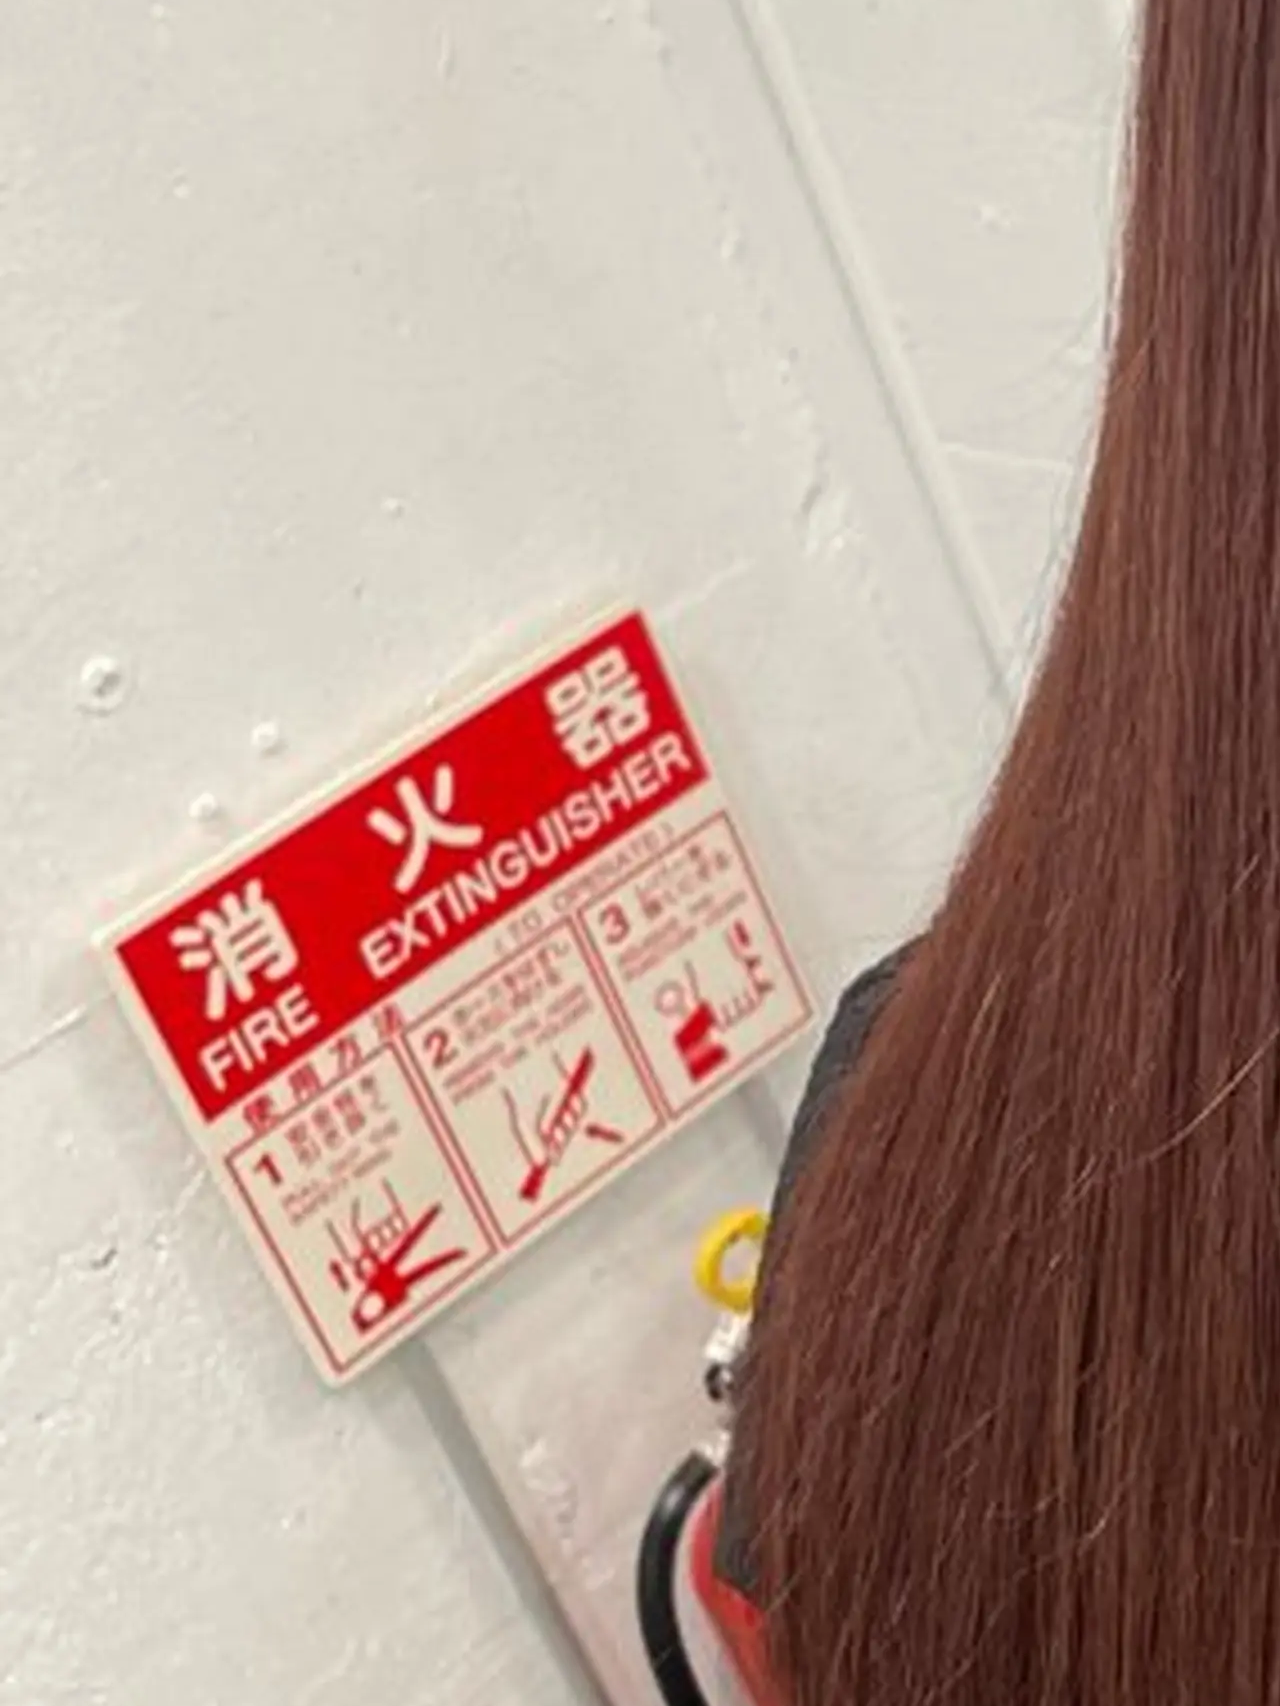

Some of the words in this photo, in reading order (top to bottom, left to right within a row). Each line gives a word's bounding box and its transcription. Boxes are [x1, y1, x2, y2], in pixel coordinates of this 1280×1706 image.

[170, 646, 650, 1021] 消火器
[198, 983, 319, 1092] FIRE
[359, 735, 694, 980] EXTINGUISHER
[599, 904, 631, 945] 3
[424, 1030, 459, 1069] 2
[253, 1153, 283, 1185] 1
